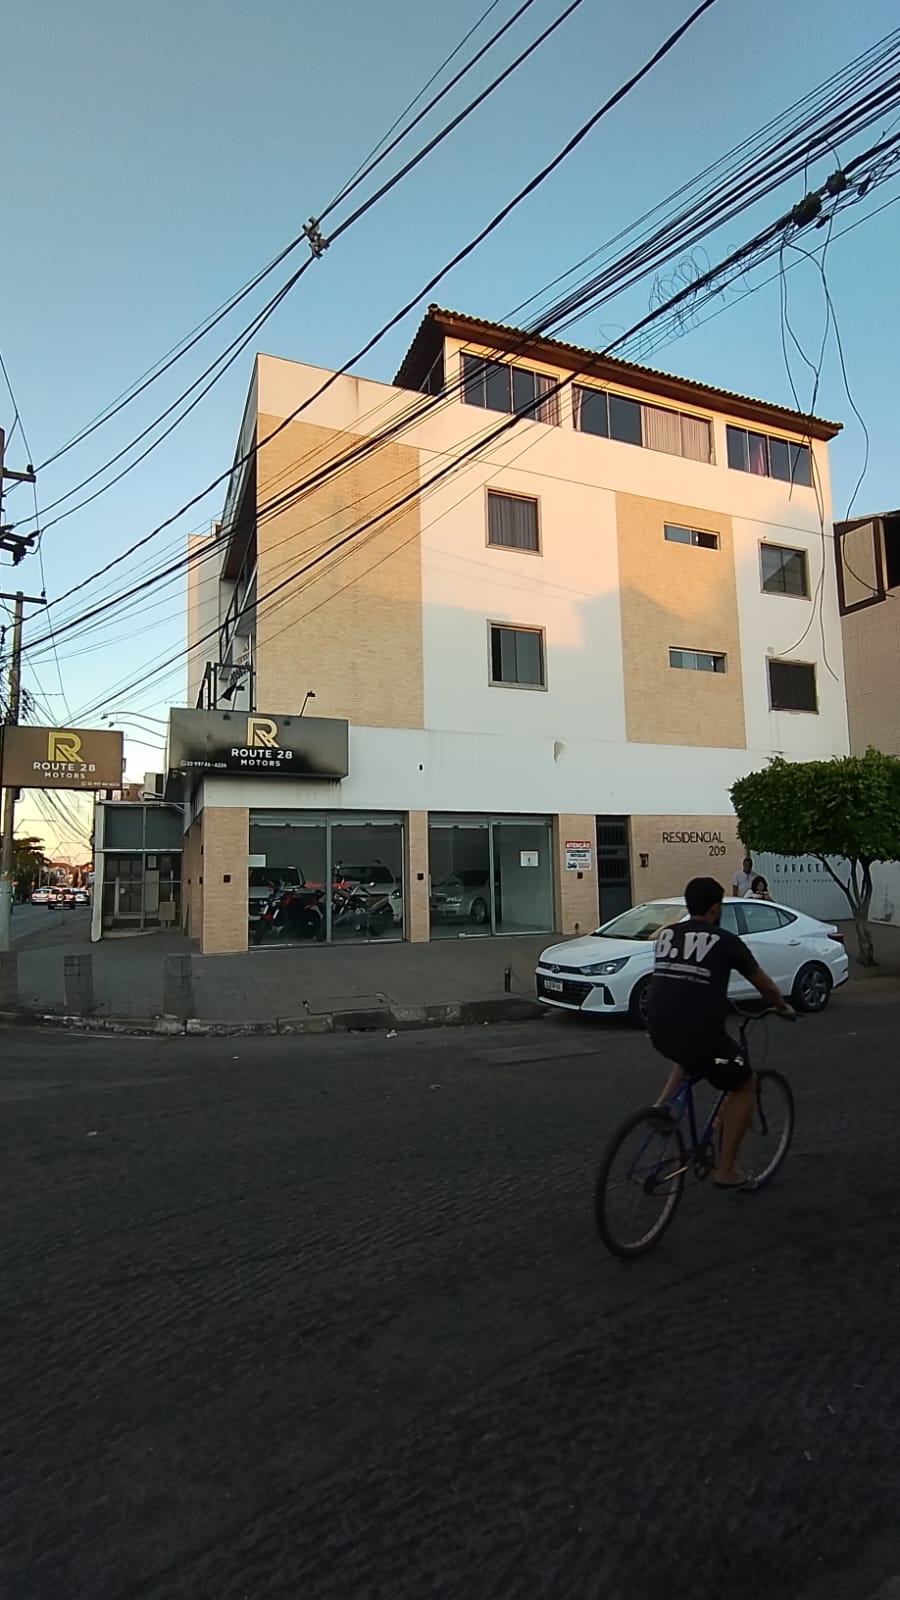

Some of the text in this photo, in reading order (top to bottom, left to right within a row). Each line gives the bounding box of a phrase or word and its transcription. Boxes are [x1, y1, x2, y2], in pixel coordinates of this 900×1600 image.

[231, 748, 293, 760] ROUTE 28
[33, 761, 96, 772] ROUTE 28
[240, 759, 281, 767] MOTORS
[44, 771, 85, 779] MOTORS
[662, 831, 724, 844] RESIDENCIAL
[708, 845, 726, 857] 209
[655, 928, 721, 962] B.W
